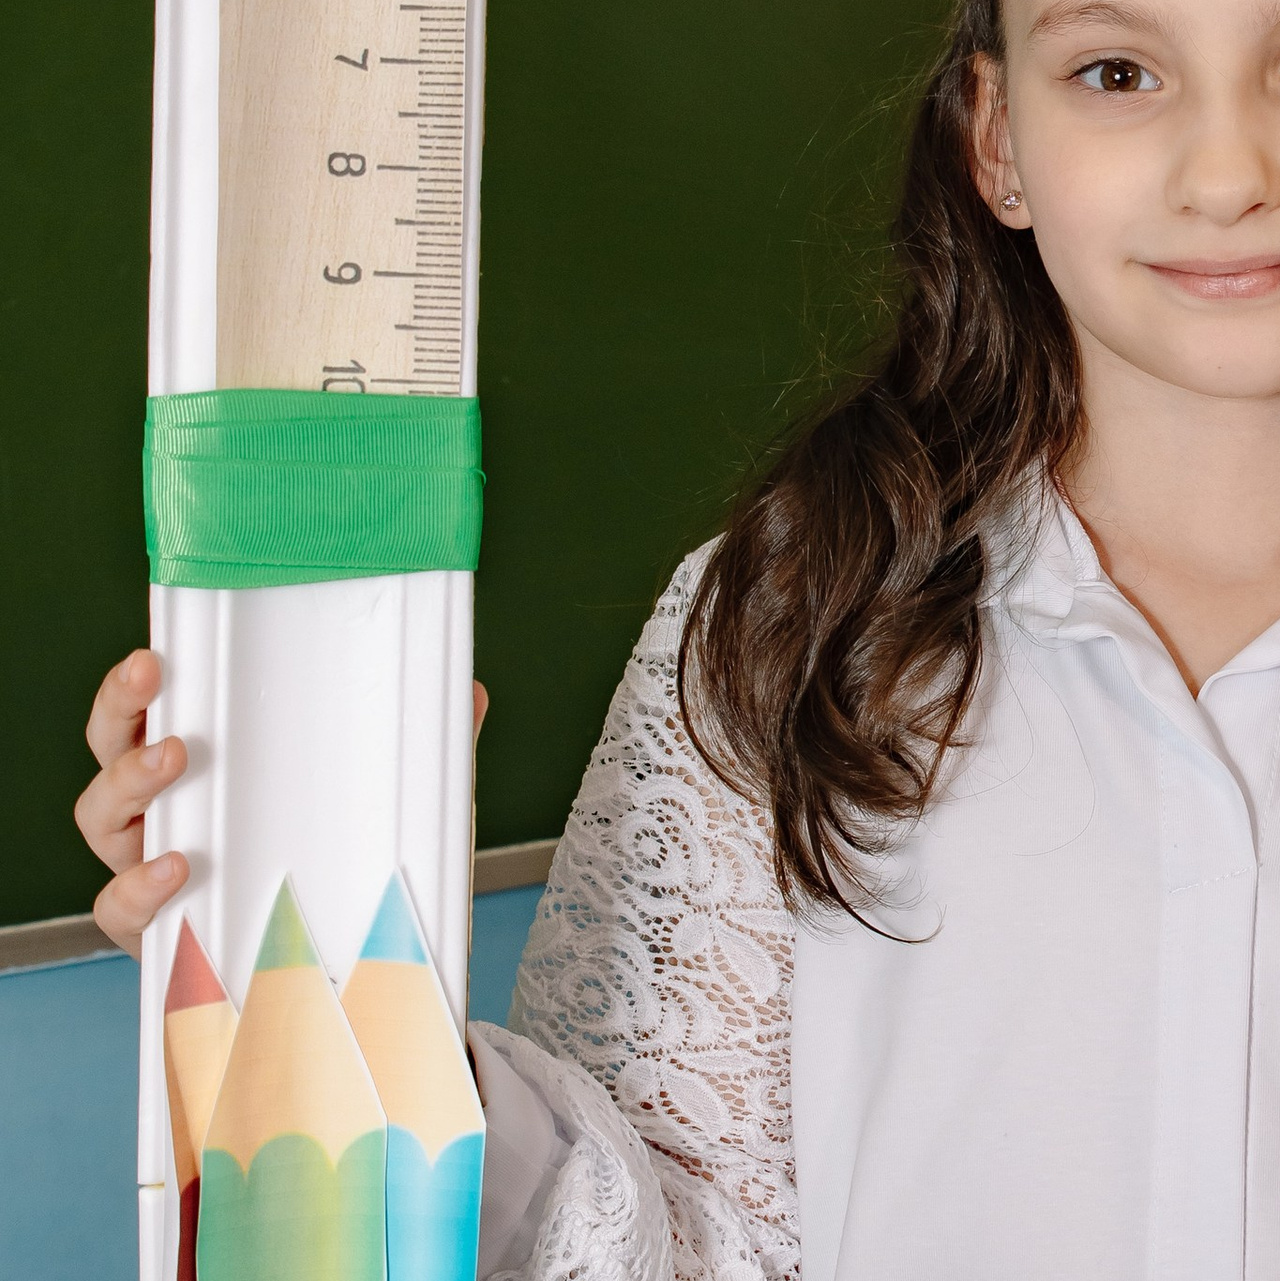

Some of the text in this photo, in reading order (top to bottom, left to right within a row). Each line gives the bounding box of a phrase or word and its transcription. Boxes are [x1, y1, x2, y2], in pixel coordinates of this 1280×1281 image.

[334, 48, 369, 71] 7
[327, 151, 367, 177] 8
[323, 261, 362, 286] 9
